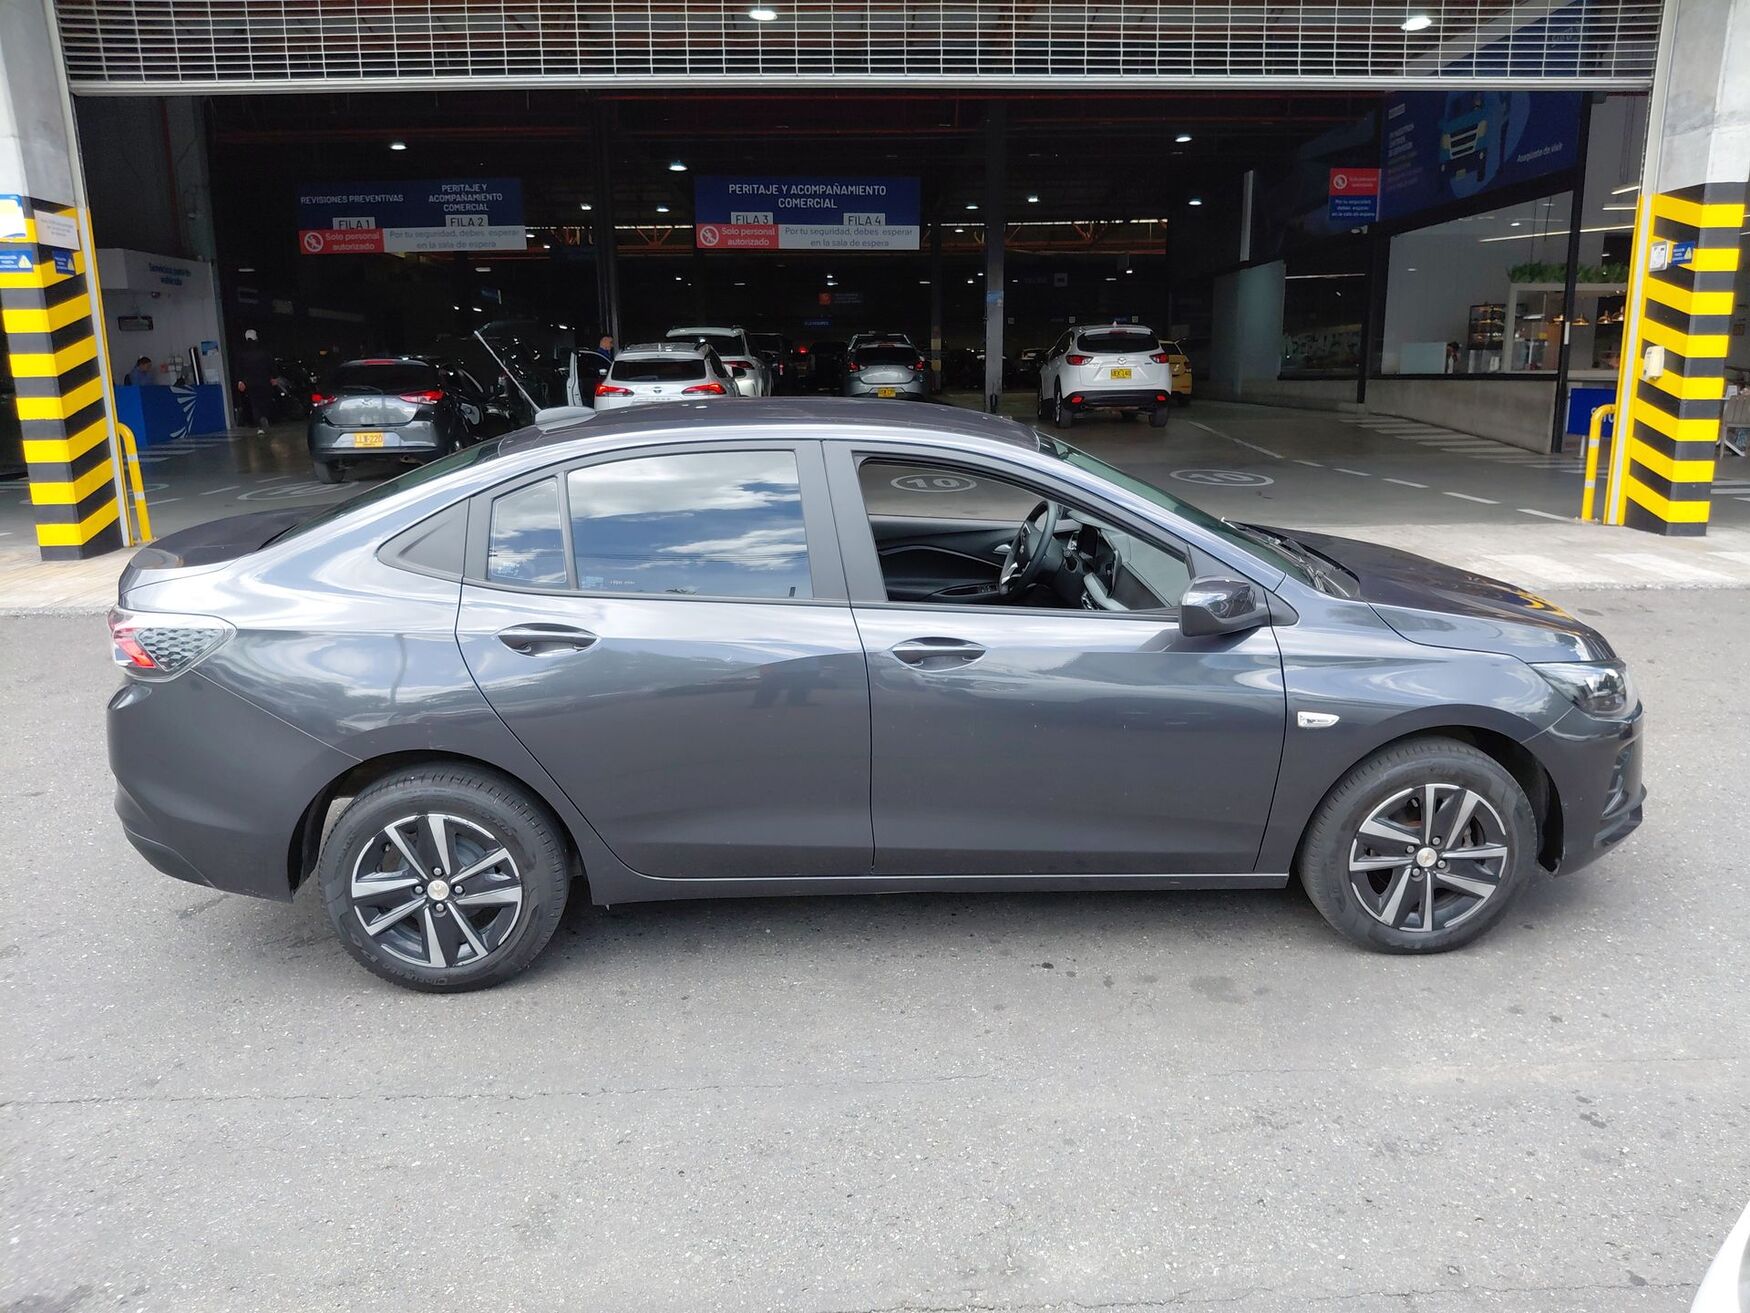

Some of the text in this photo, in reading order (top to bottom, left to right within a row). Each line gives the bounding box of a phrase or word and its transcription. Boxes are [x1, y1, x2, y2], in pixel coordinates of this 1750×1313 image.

[441, 183, 488, 193] PERITAJE Y
[729, 183, 887, 196] PERITAJE Y ACOMPAÑAMIENTO
[300, 193, 404, 205] REVISIONES PREVENTIVAS
[428, 192, 503, 203] ACOMPAÑAMIENTO
[443, 203, 489, 212] COMERCIAL
[778, 198, 838, 209] COMERCIAL
[338, 219, 363, 229] FILA
[450, 217, 484, 227] FILA 2
[736, 215, 769, 225] FILA 3
[849, 215, 881, 226] FILA 4
[324, 231, 380, 242] Solo personal
[721, 227, 776, 237] Solo personal
[785, 228, 798, 236] Por
[800, 228, 808, 236] tu
[882, 229, 912, 238] esperar
[332, 243, 376, 251] autorizado
[456, 241, 467, 249] de
[727, 238, 770, 246] autorizado
[823, 239, 830, 247] la
[831, 239, 848, 247] sala
[849, 239, 861, 247] de
[862, 240, 889, 249] espera
[1188, 472, 1255, 483] 10
[906, 478, 960, 488] 10
